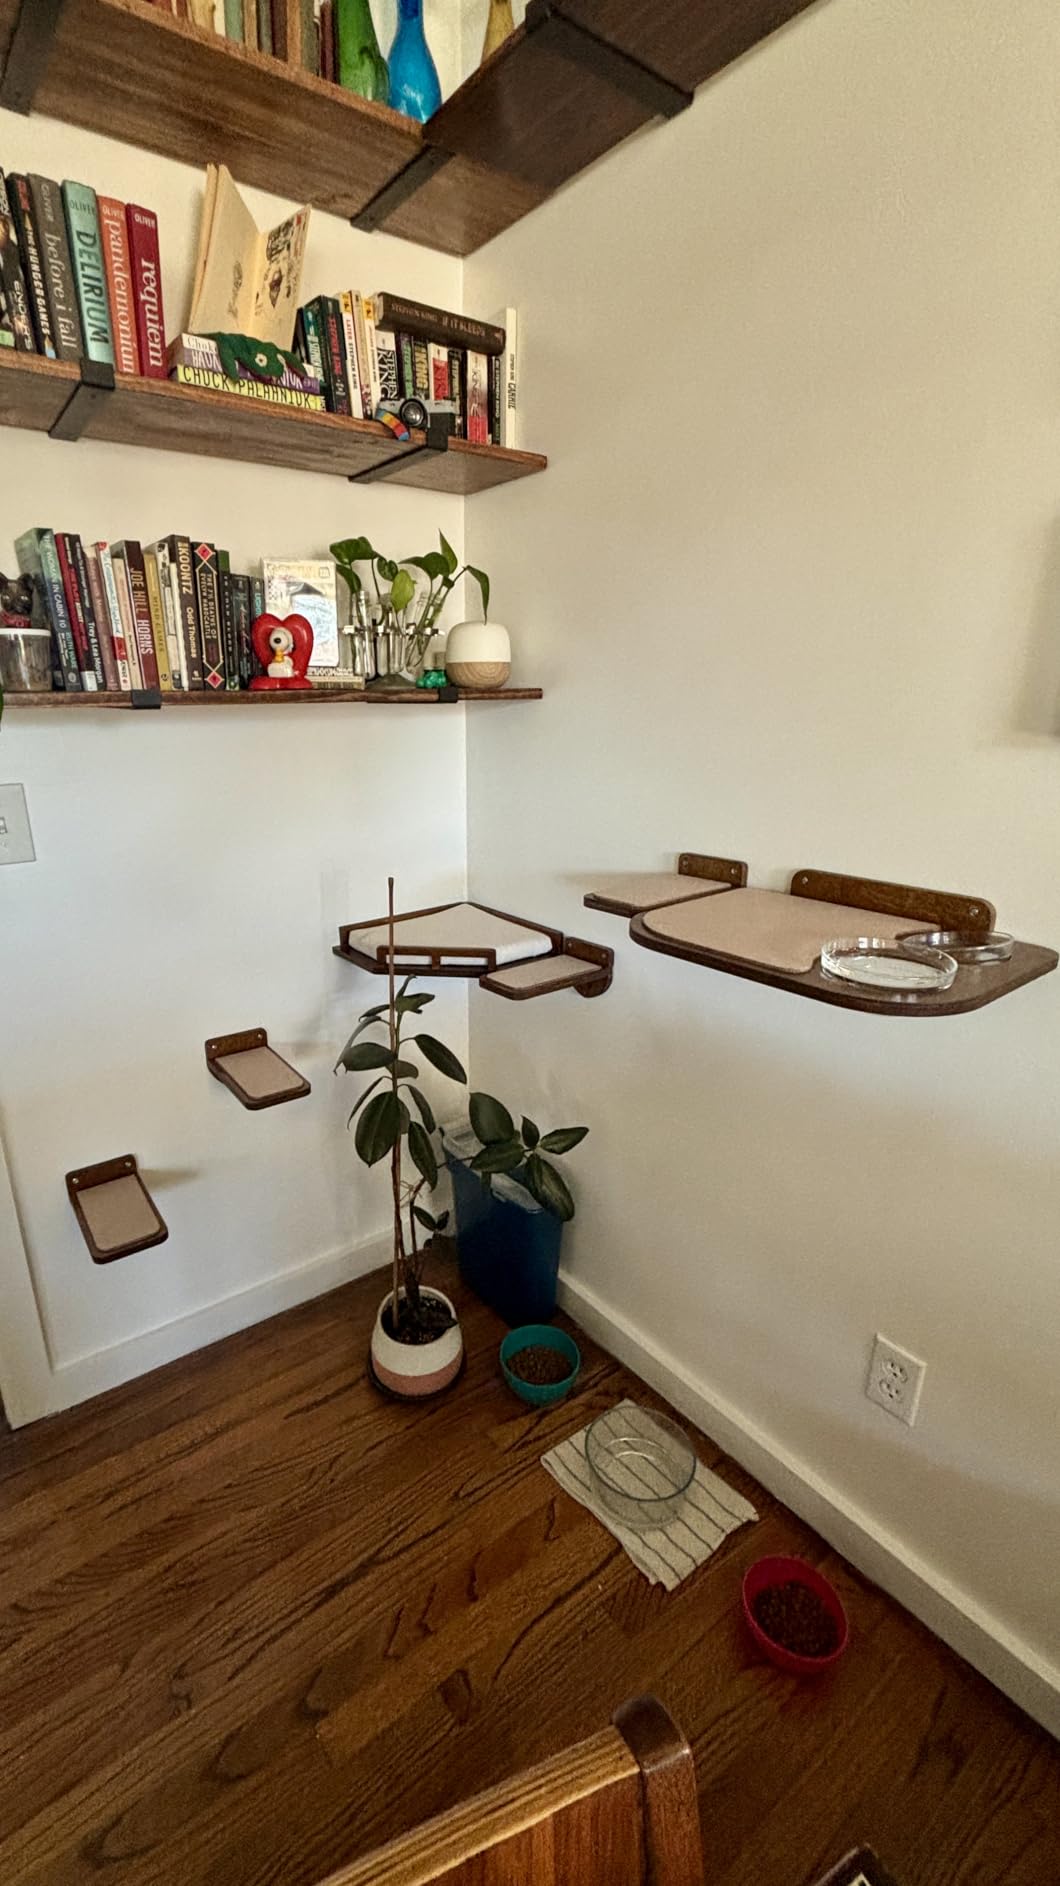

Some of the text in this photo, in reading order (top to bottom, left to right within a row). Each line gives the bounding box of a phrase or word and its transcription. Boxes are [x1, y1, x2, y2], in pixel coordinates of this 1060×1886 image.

[70, 200, 96, 217] OLIVER
[102, 204, 125, 220] OLIVER
[134, 213, 156, 229] OLIVER
[29, 246, 44, 295] HUNGER
[45, 232, 78, 349] before i fall
[75, 230, 110, 345] DELIRIUM
[36, 296, 50, 336] GAMES
[141, 258, 164, 368] requiem
[191, 350, 222, 373] HAUN
[348, 342, 356, 372] STEPHEN
[183, 366, 231, 391] CHUCK
[238, 380, 312, 410] PALAHNIUK
[376, 350, 391, 399] KING
[387, 350, 399, 399] STEPHEN
[508, 383, 516, 410] CARRIE
[46, 551, 59, 584] WOMAN
[178, 545, 193, 596] KOONTZ
[51, 584, 60, 595] IN
[255, 593, 263, 614] LIGHT
[54, 595, 65, 618] CABIN
[130, 568, 153, 656] JOE HILL HORNS
[59, 621, 67, 629] 10
[88, 622, 97, 638] Trey
[186, 607, 198, 658] Odd Thomas
[92, 645, 101, 658] Lea
[94, 657, 104, 684] Morgan
